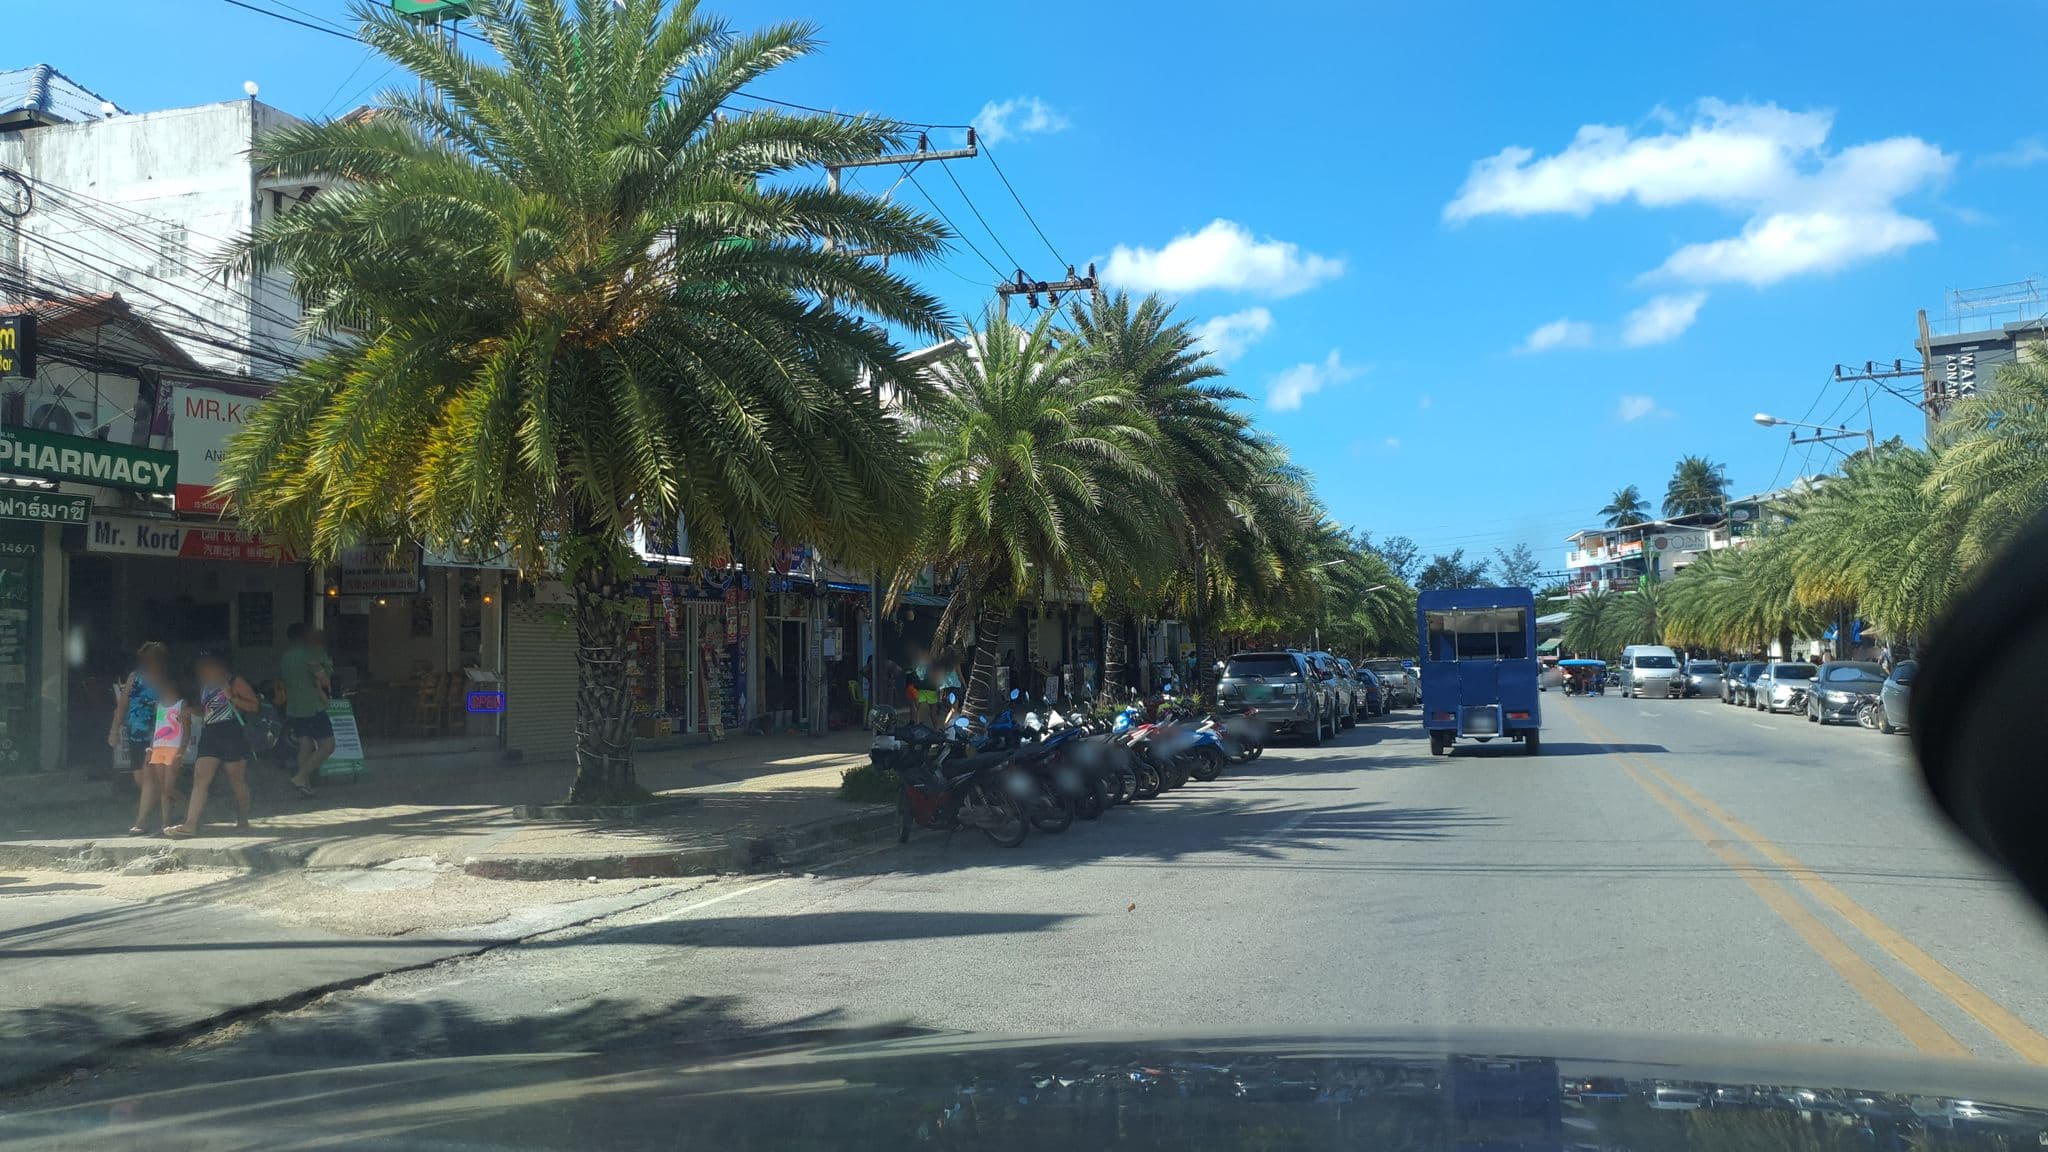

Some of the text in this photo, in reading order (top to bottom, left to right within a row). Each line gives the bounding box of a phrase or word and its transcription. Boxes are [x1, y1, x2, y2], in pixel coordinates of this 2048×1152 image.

[0, 439, 171, 487] PHARMACY
[94, 521, 180, 550] Mr. Kord
